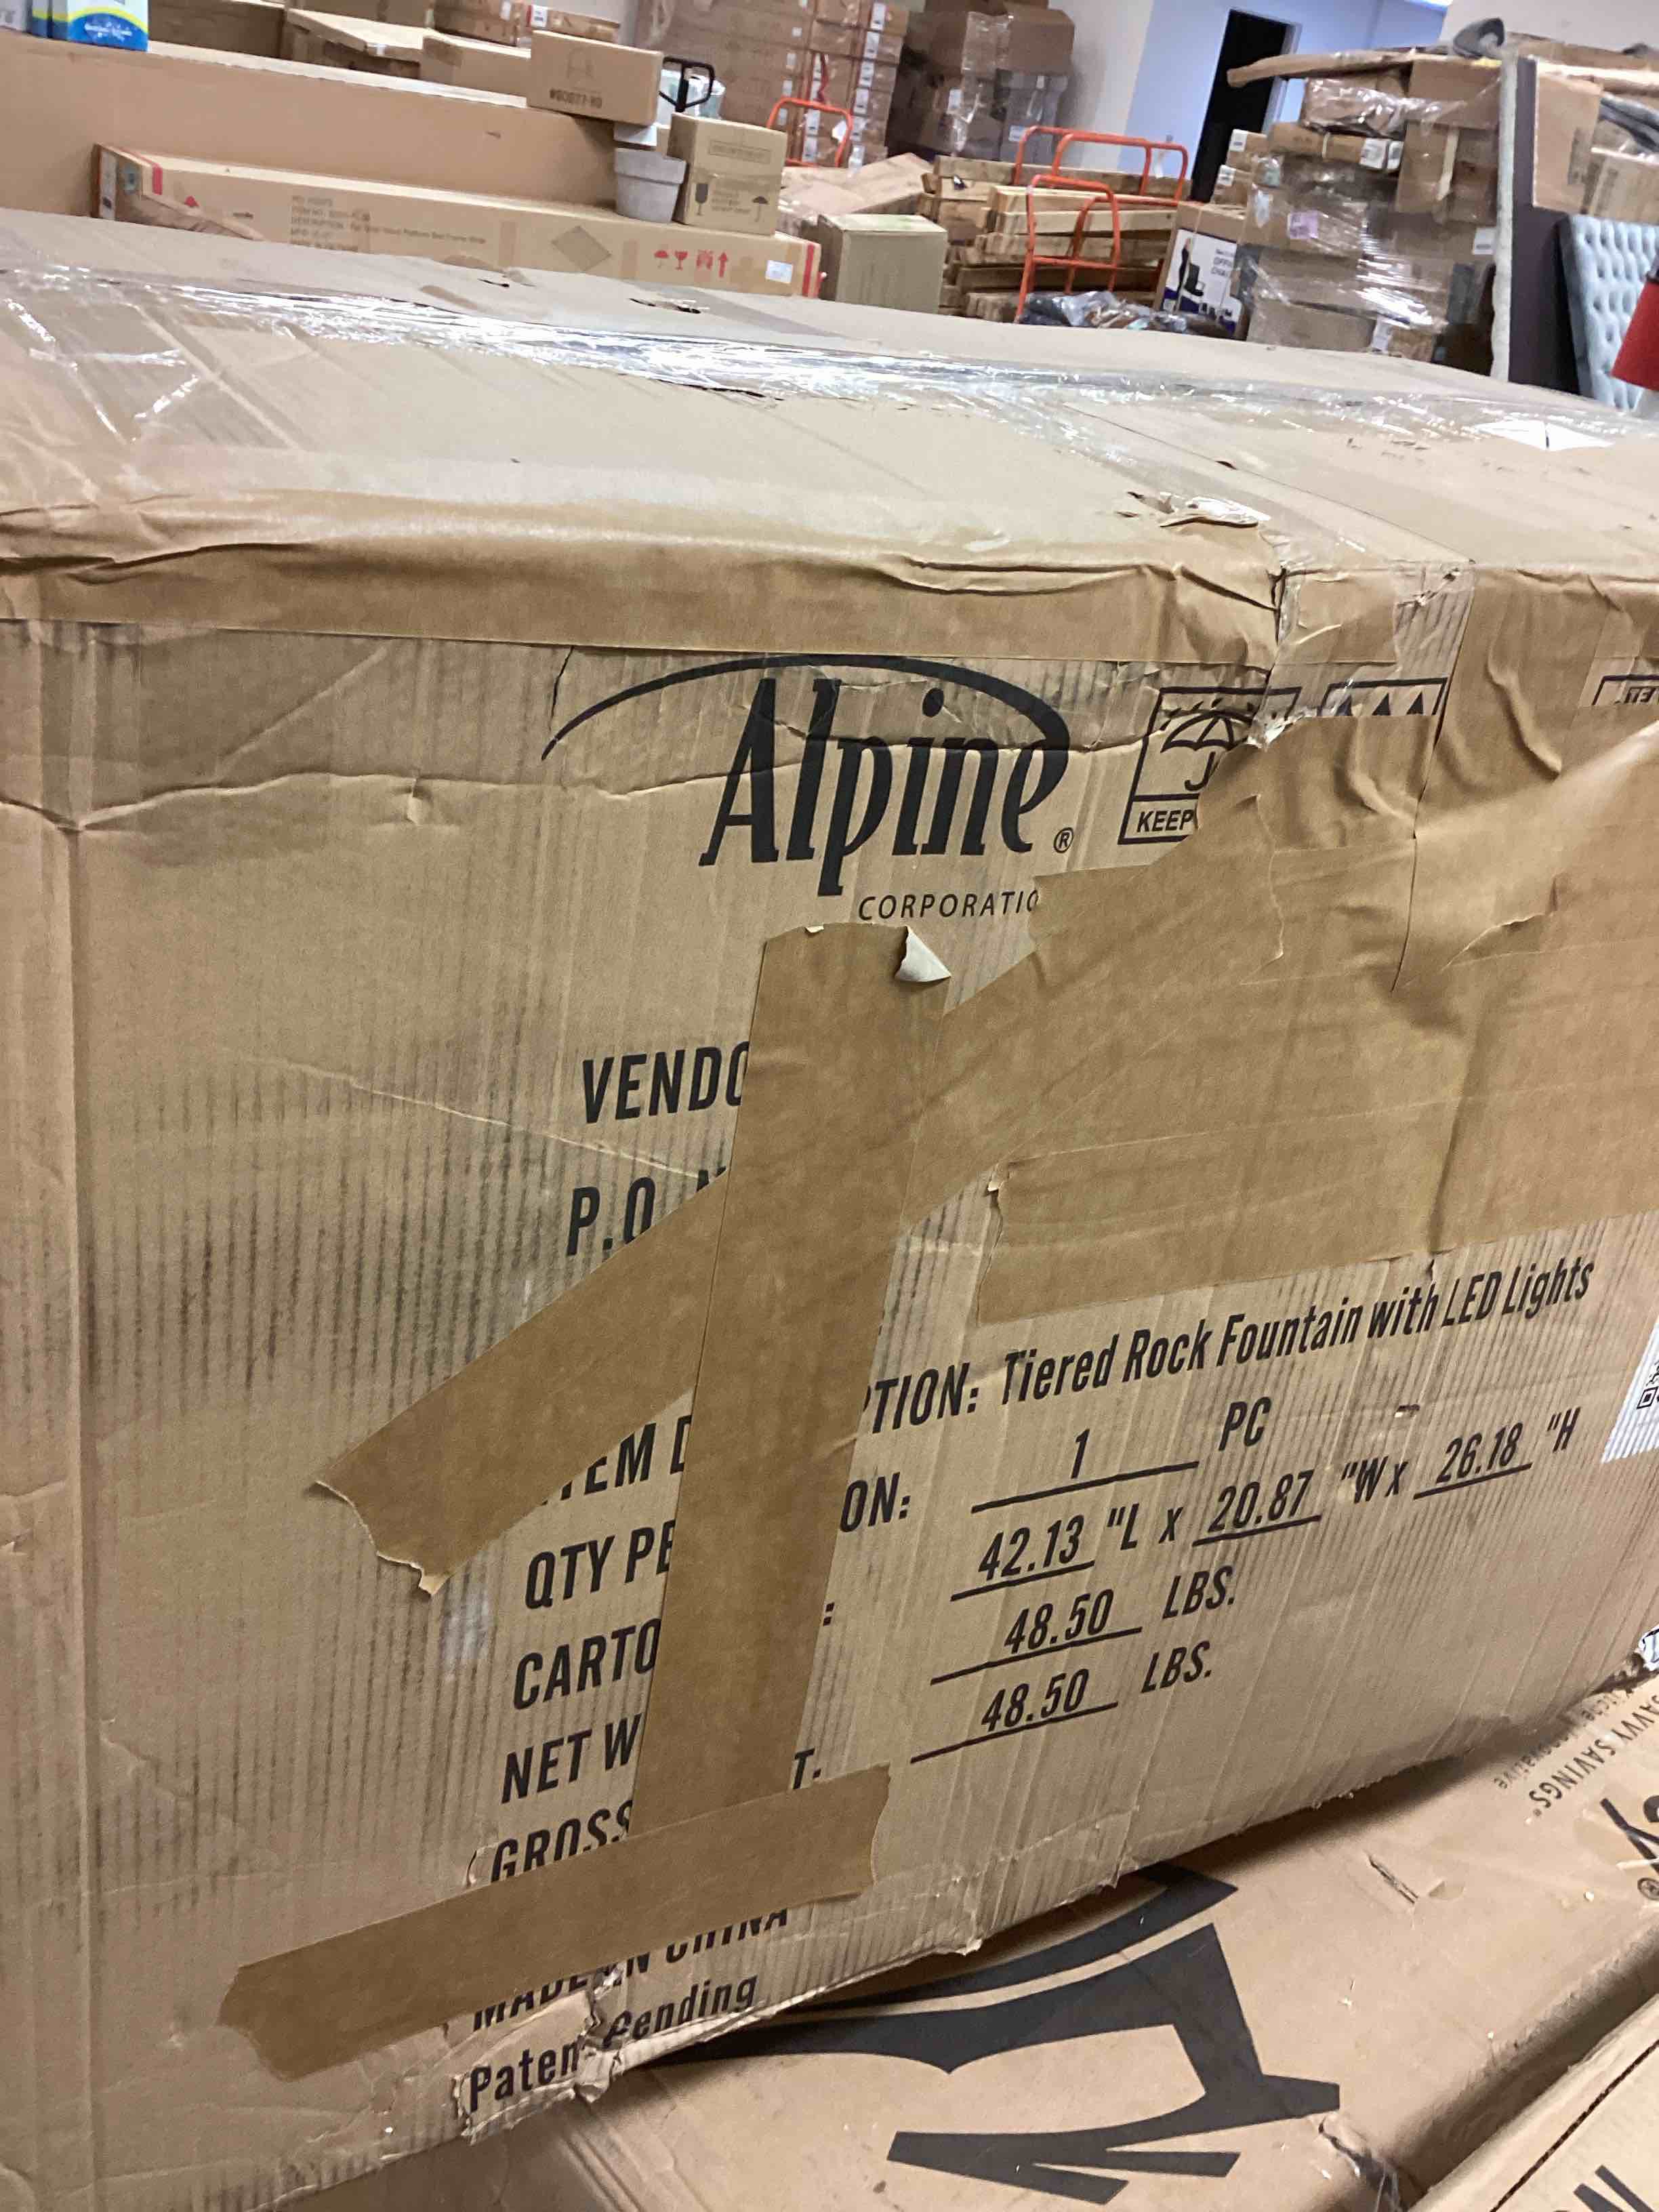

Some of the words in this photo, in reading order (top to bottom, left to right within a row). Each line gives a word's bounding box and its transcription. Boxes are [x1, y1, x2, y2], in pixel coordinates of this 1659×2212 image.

[699, 676, 1071, 897] Alpine
[1136, 808, 1195, 834] KEEP
[862, 1361, 979, 1435] TION:
[1001, 1332, 1120, 1406] Tiered
[1121, 1318, 1213, 1383] Rock
[1215, 1296, 1364, 1368] Fountain
[1366, 1284, 1439, 1339] with
[1440, 1272, 1502, 1328] LED
[1500, 1256, 1595, 1320] Lights
[525, 1534, 616, 1610] QTY
[1070, 1428, 1090, 1479] 1
[1218, 1396, 1272, 1452] PC
[977, 1514, 1086, 1582] 42.13
[1208, 1469, 1315, 1533] 20.87
[1435, 1422, 1524, 1483] 26.18
[501, 1728, 593, 1805] NET
[1004, 1588, 1115, 1655] 48.50
[1162, 1565, 1236, 1620] LBS.
[981, 1667, 1090, 1732] 48.50
[1140, 1640, 1213, 1694] LBS.
[470, 2039, 584, 2113] Paten
